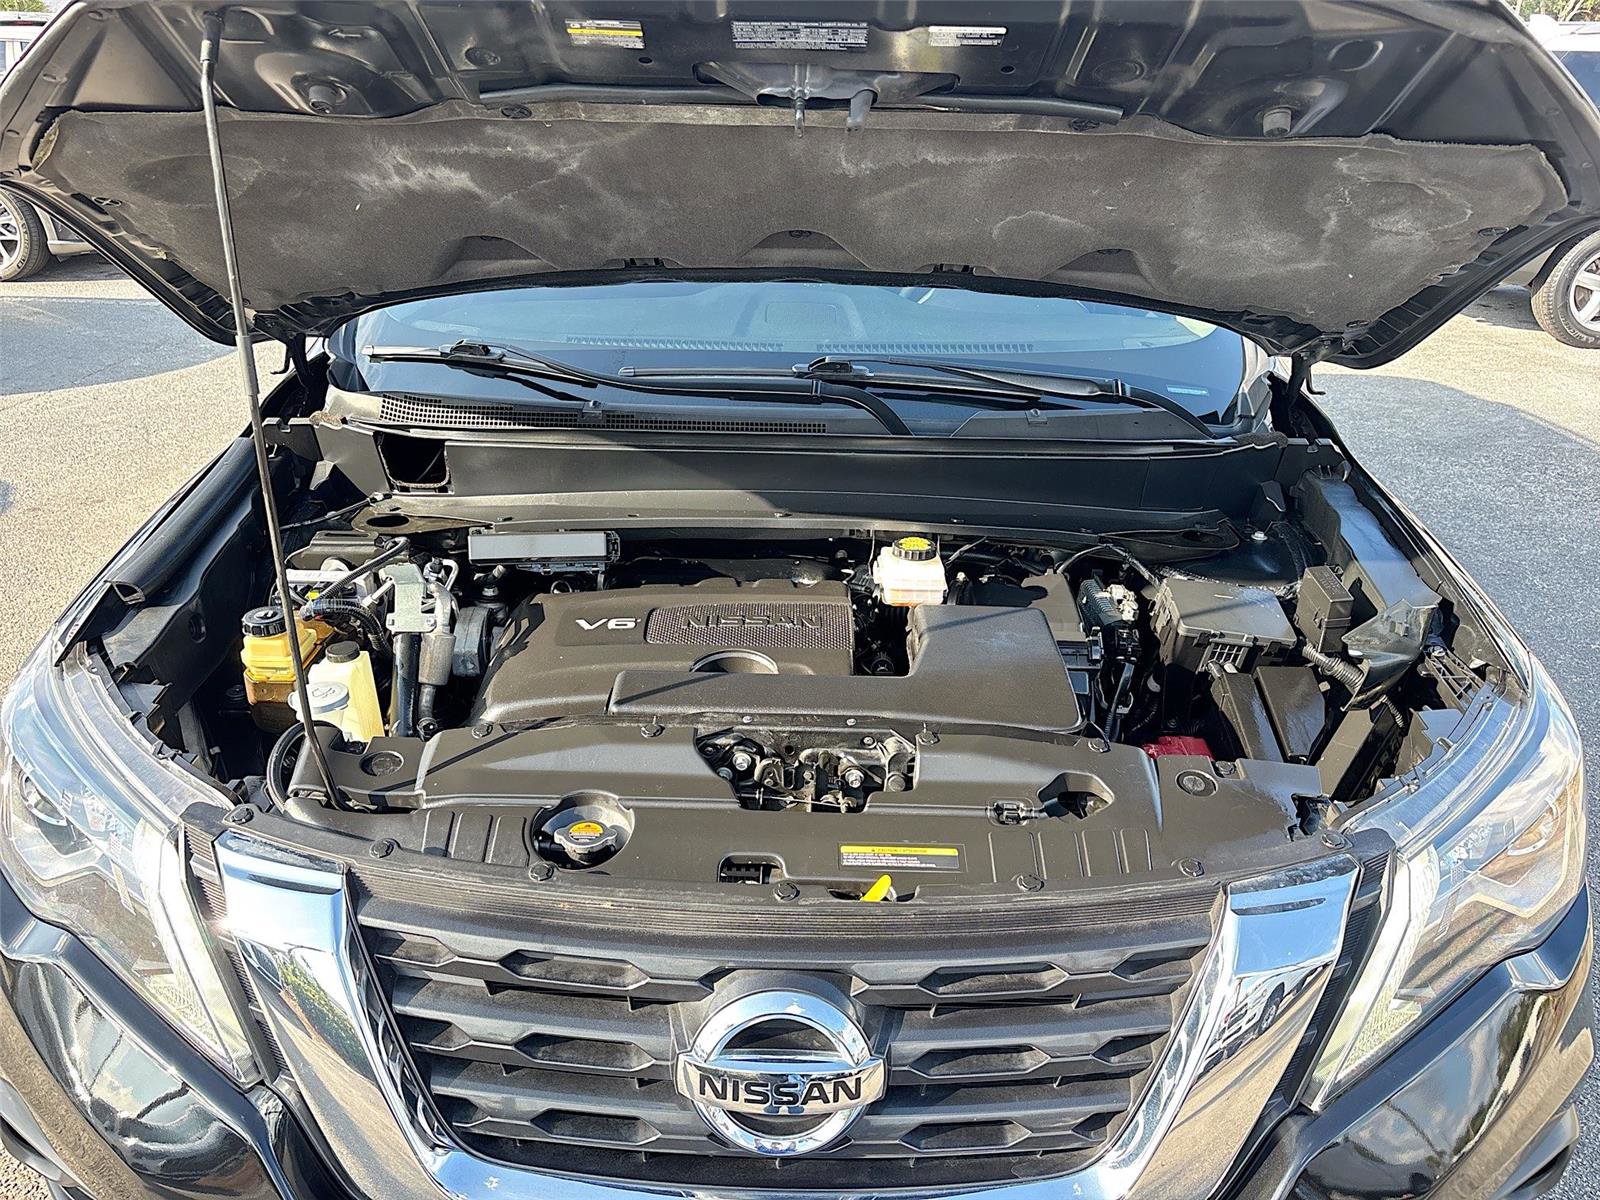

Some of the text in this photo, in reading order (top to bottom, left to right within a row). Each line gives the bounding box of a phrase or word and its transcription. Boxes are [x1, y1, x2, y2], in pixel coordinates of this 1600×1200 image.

[575, 618, 637, 630] V6
[682, 615, 822, 629] NISSAN
[700, 1075, 861, 1106] NISSAN
